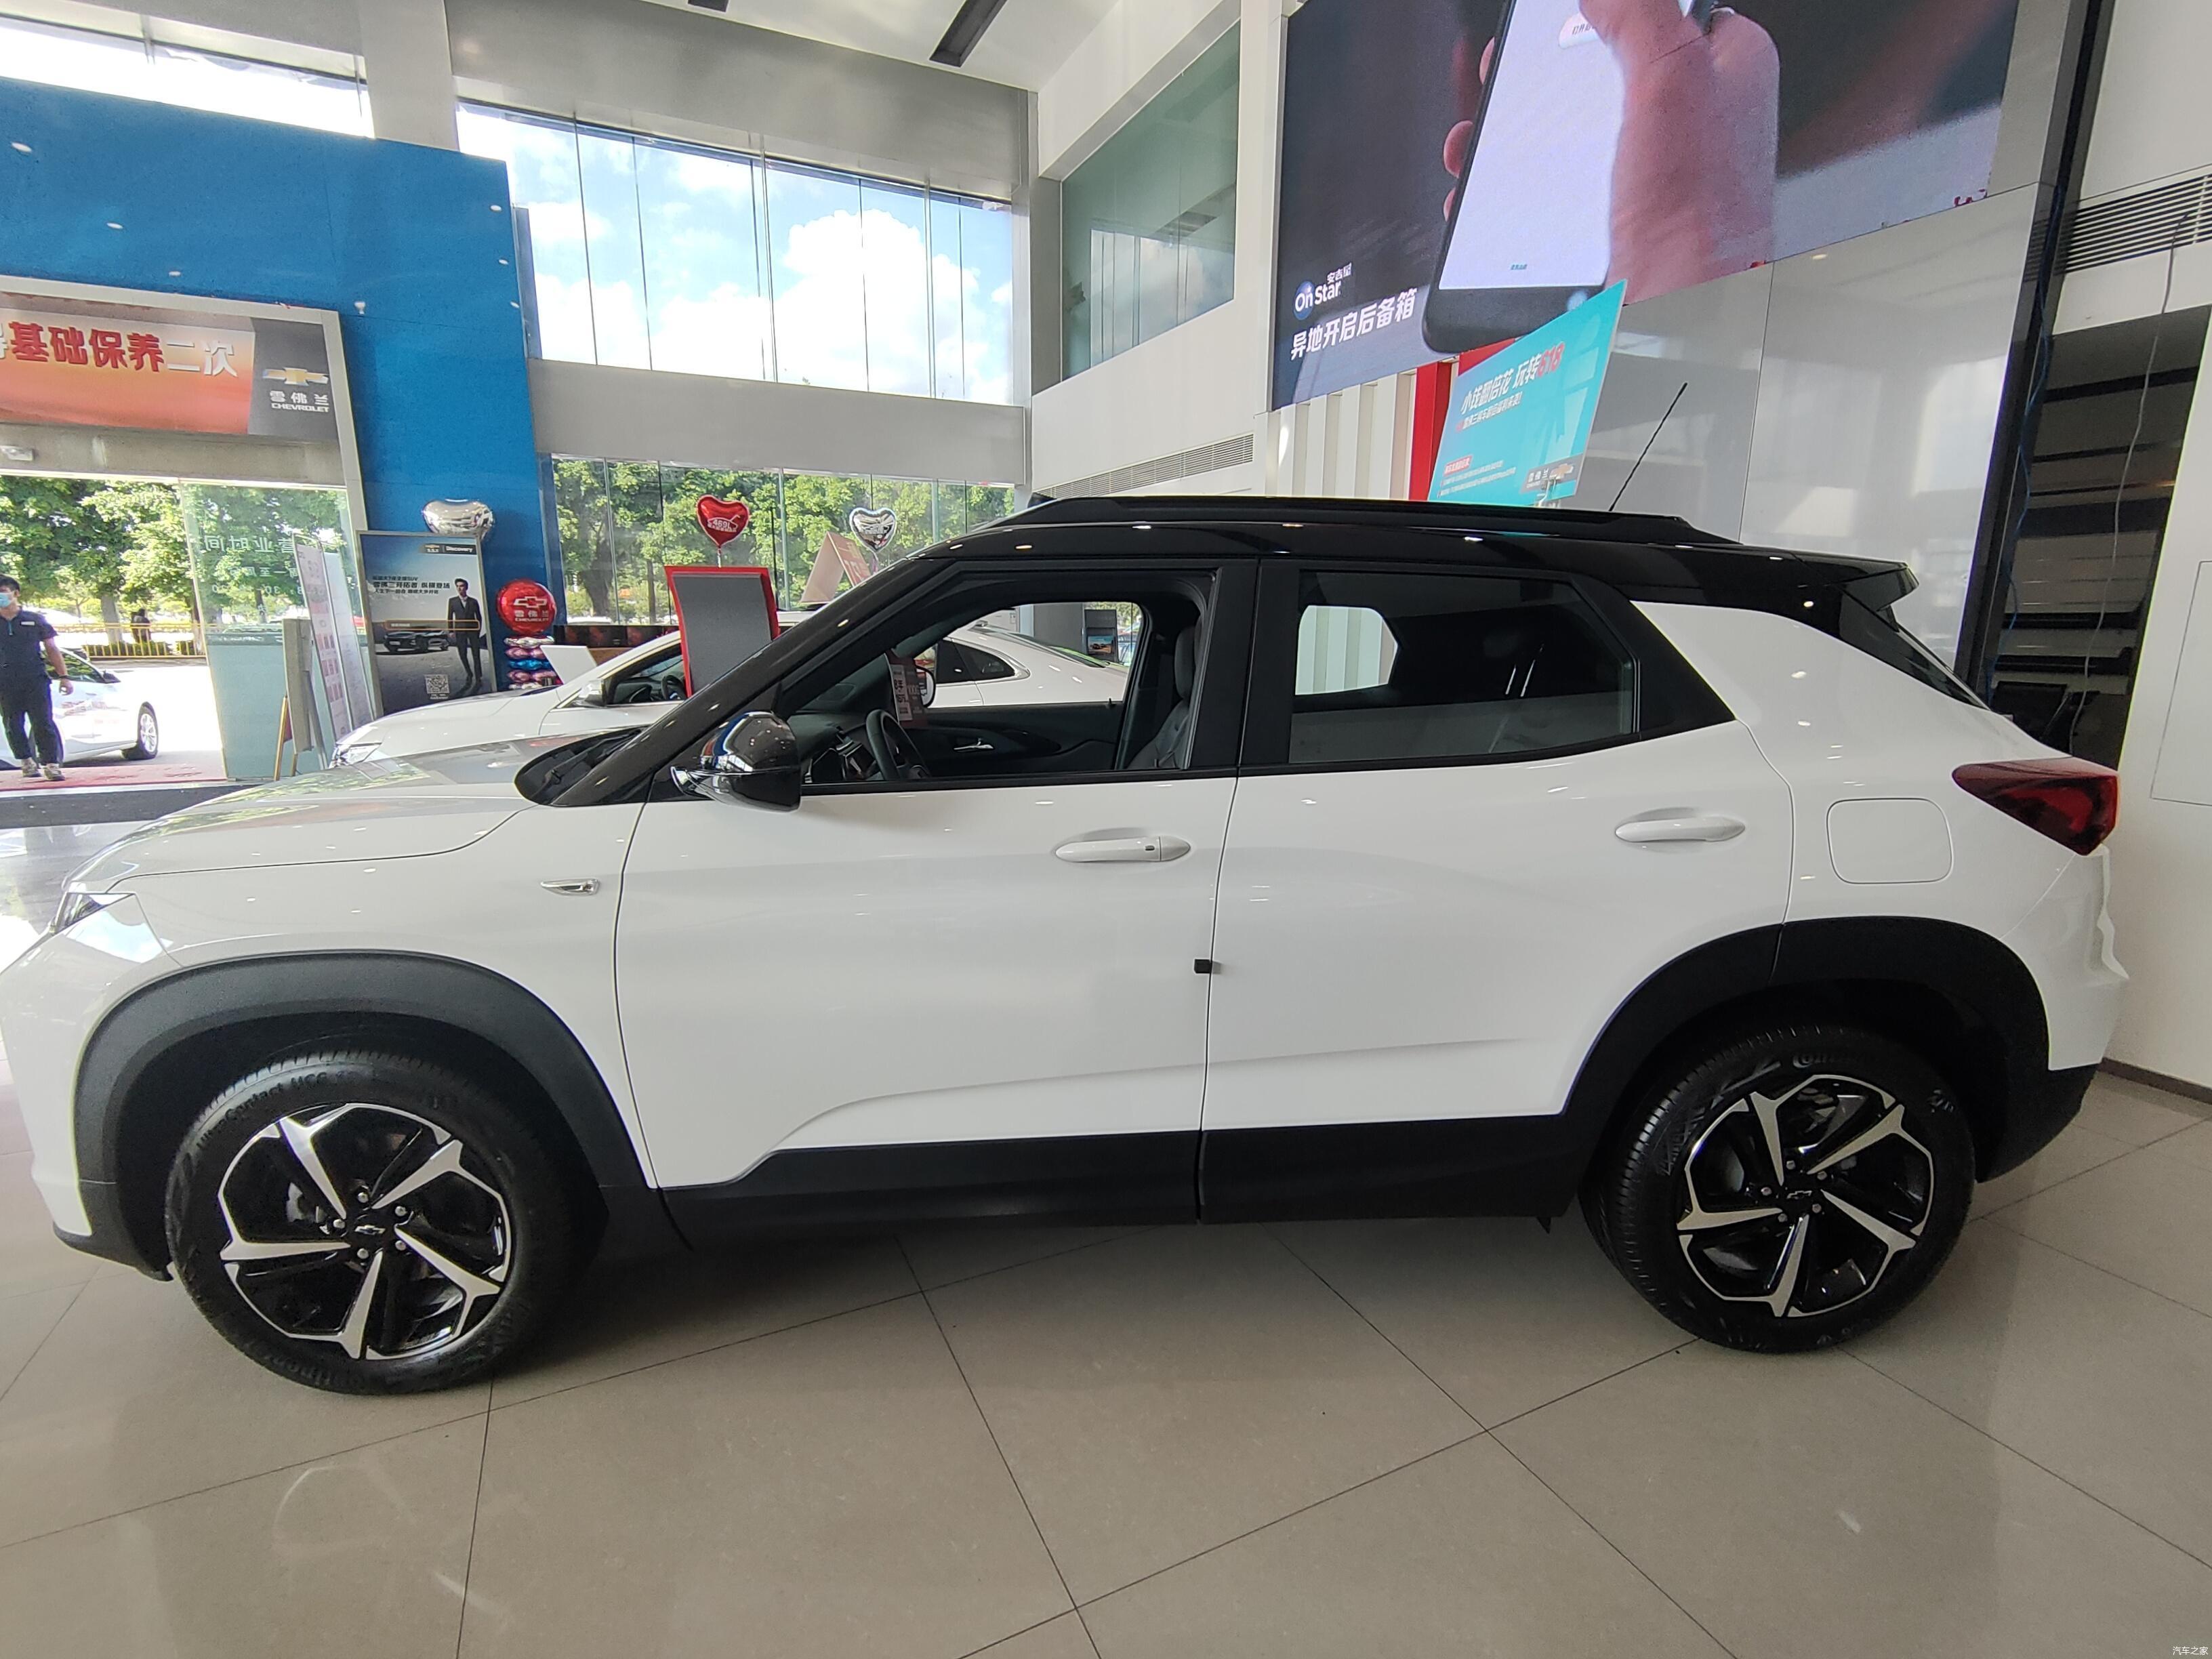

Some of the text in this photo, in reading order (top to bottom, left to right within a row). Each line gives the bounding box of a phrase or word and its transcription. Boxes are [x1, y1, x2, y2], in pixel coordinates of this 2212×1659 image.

[1326, 262, 1351, 284] 安吉星
[1291, 287, 1418, 361] 异地开启后备箱
[0, 321, 238, 377] 基础保养二次
[270, 390, 329, 405] 雪佛兰
[271, 403, 329, 413] CHEVROLET
